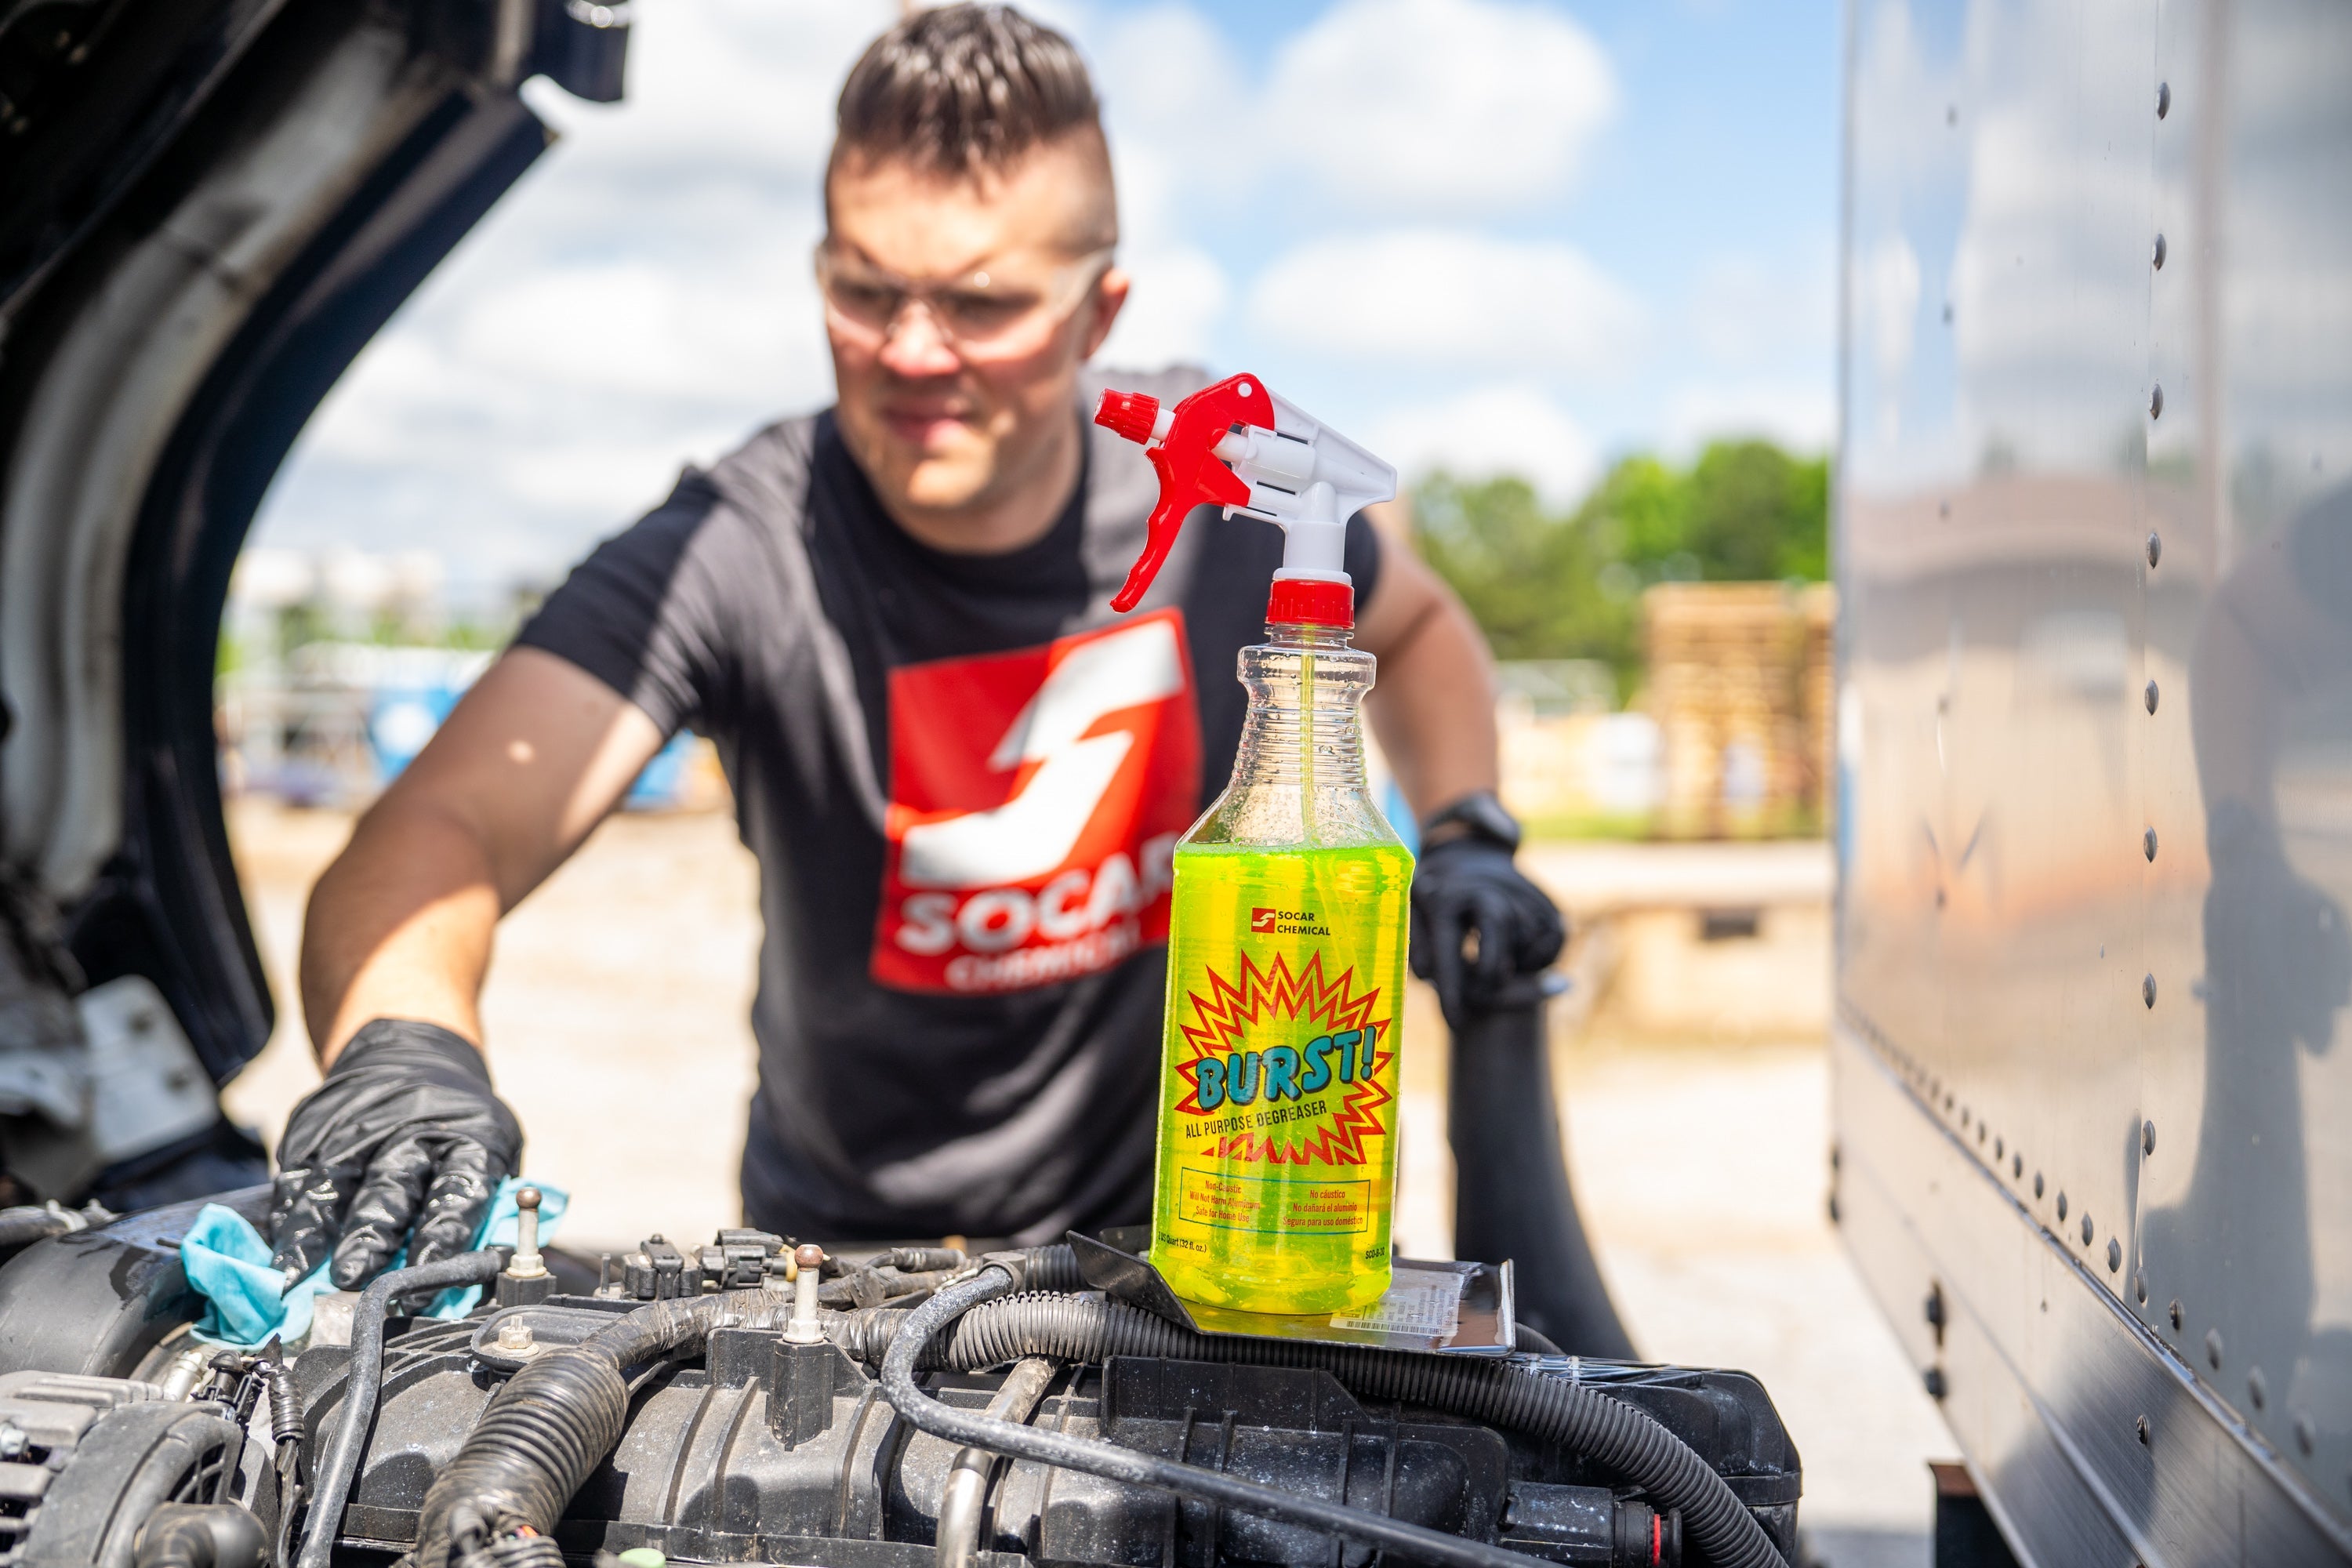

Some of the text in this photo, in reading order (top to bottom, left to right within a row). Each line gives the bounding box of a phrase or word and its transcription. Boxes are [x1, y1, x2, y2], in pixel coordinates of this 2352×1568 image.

[1278, 911, 1315, 921] SOCAR
[1277, 925, 1330, 935] CHEMICAL
[1196, 1025, 1377, 1112] BURST!
[1185, 1100, 1327, 1138] ALL PURPOSE DEGREASER
[1206, 1180, 1242, 1193] Non-Caustic
[1189, 1190, 1261, 1209] Will Not Harm Aluminum
[1310, 1189, 1345, 1199] No cáustico
[1293, 1202, 1358, 1212] No dañará el aluminio
[1196, 1206, 1208, 1215] Safe
[1218, 1210, 1236, 1220] Home
[1238, 1212, 1250, 1223] Use
[1283, 1216, 1306, 1228] Segura
[1308, 1218, 1322, 1228] para
[1335, 1216, 1363, 1225] doméstico
[1167, 1235, 1179, 1247] Quart
[1179, 1239, 1189, 1249] (32
[1196, 1243, 1207, 1254] oz.)
